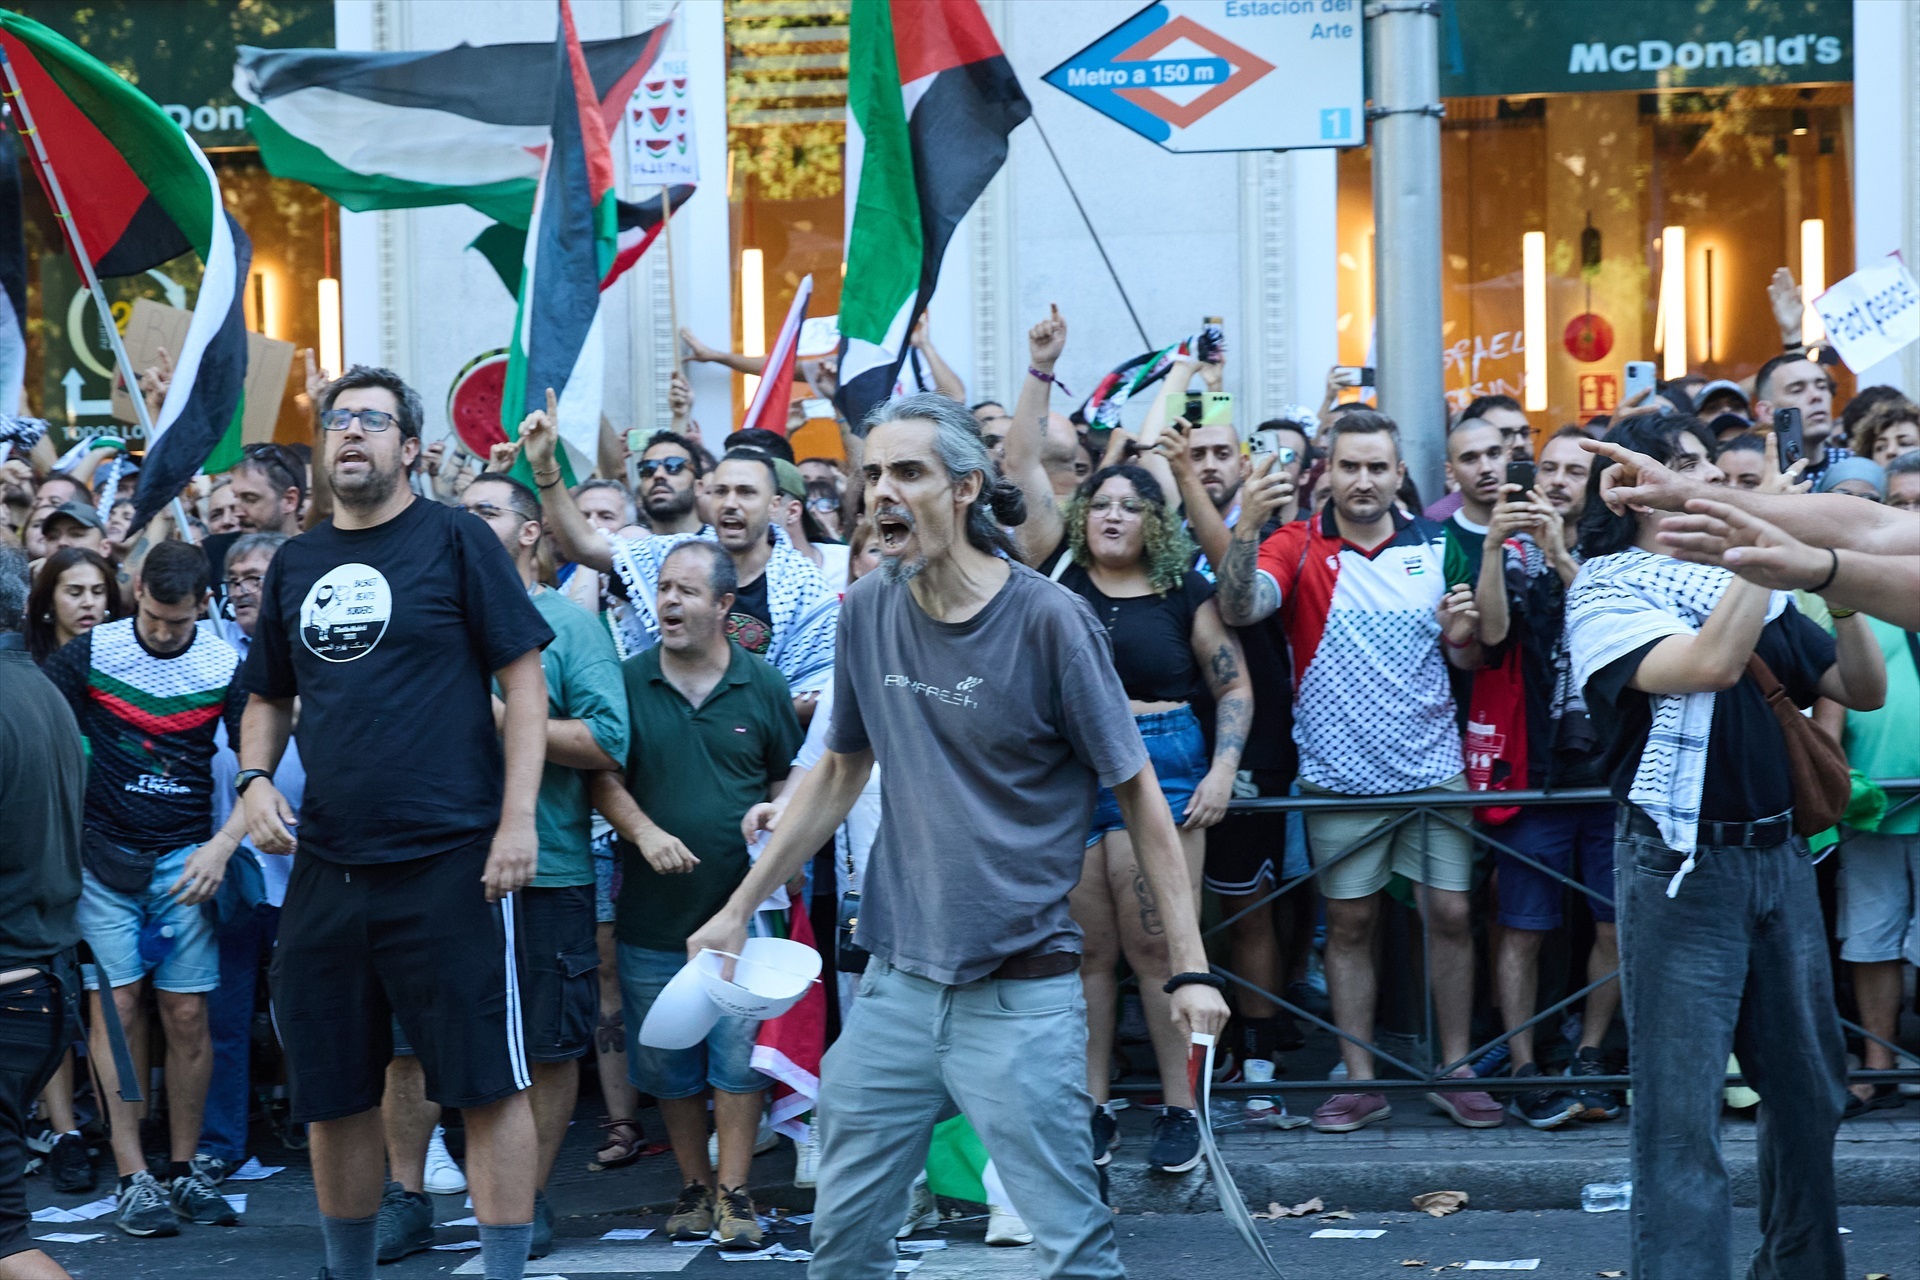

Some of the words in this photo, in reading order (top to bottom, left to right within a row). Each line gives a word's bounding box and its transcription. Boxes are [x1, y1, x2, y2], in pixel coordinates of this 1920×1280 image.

[1321, 0, 1353, 12] del
[1310, 23, 1353, 39] Arte
[1568, 34, 1842, 74] McDonald's
[1067, 67, 1128, 87] Metro
[1132, 69, 1146, 84] a
[1151, 63, 1189, 82] 150
[1194, 64, 1214, 81] m
[1327, 109, 1344, 137] 1
[1443, 329, 1526, 384] SRAEL
[61, 424, 119, 441] TODOS
[121, 424, 145, 440] LO
